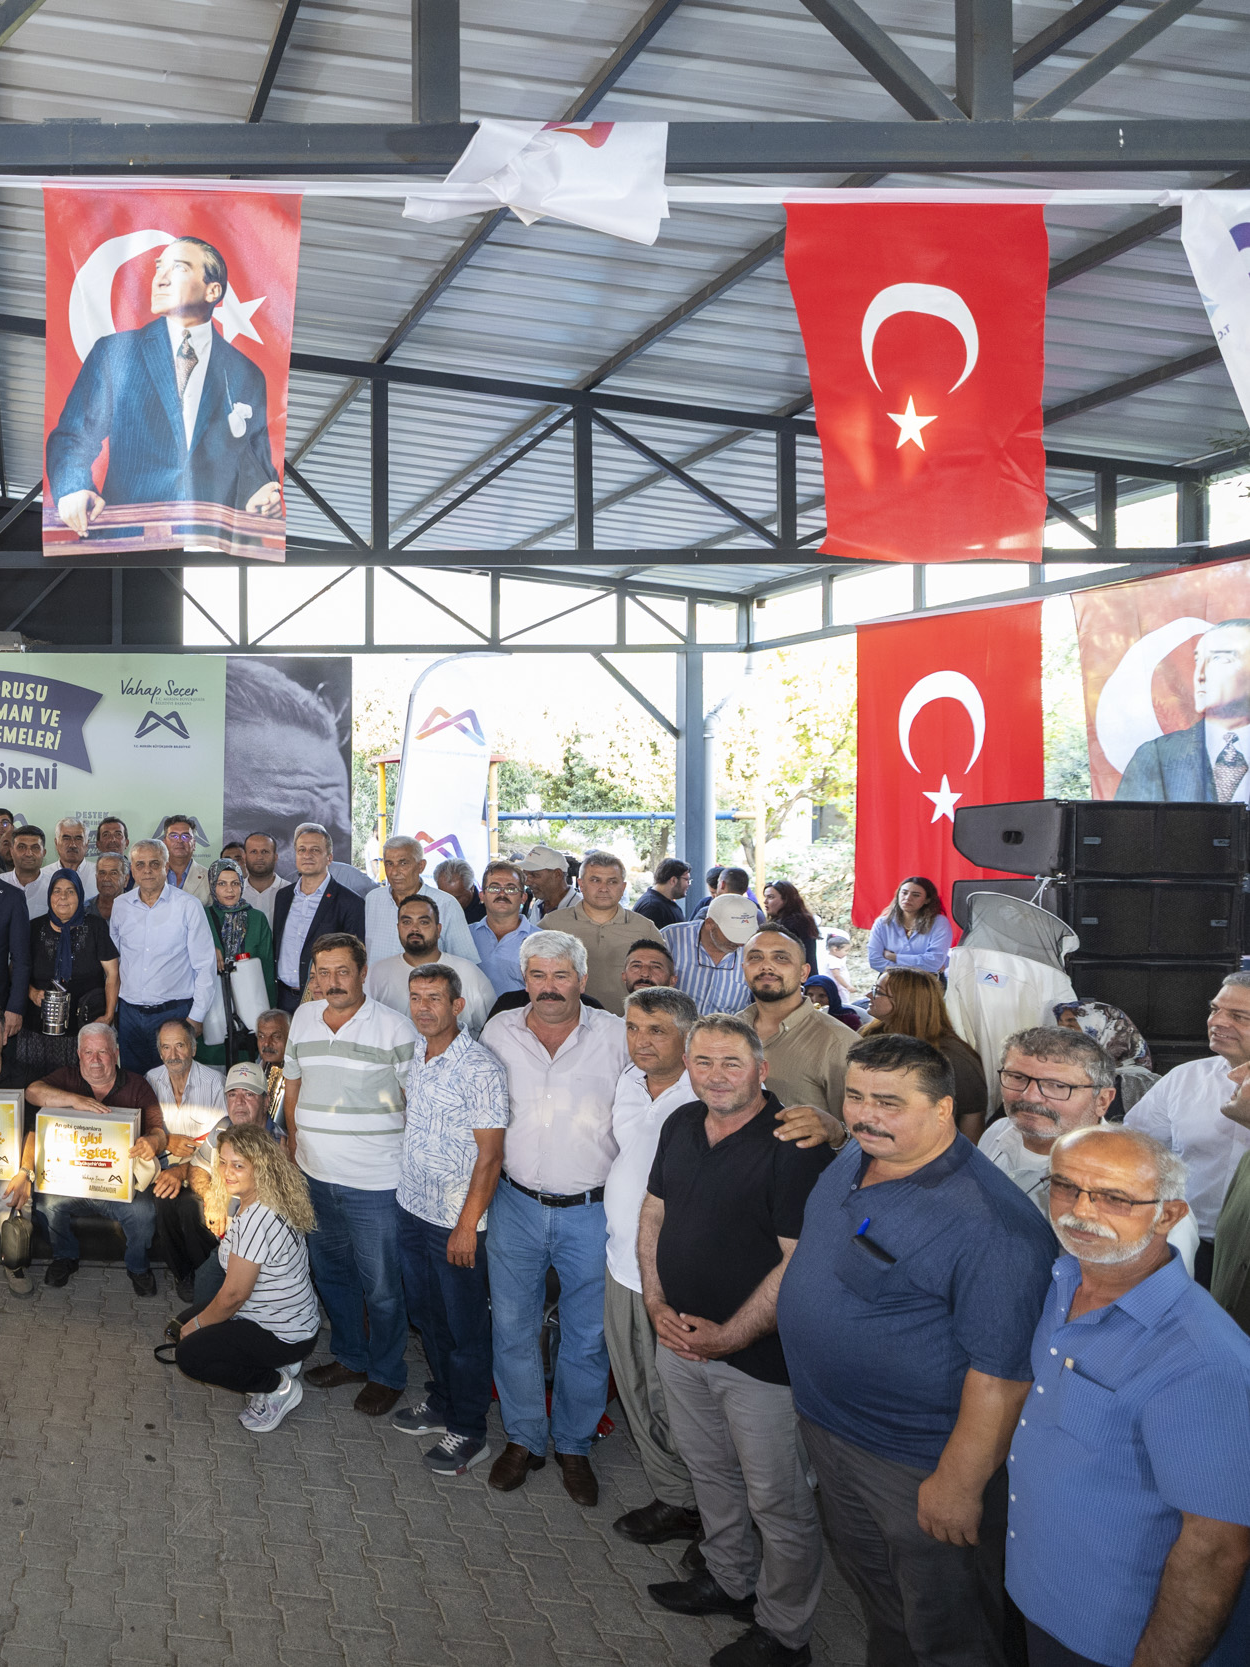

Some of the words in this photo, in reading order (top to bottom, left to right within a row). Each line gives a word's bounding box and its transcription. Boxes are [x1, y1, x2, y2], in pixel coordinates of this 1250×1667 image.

[121, 678, 162, 704] Vahap
[165, 680, 198, 697] Seçer
[40, 708, 61, 728] VE
[80, 1132, 102, 1147] gibi
